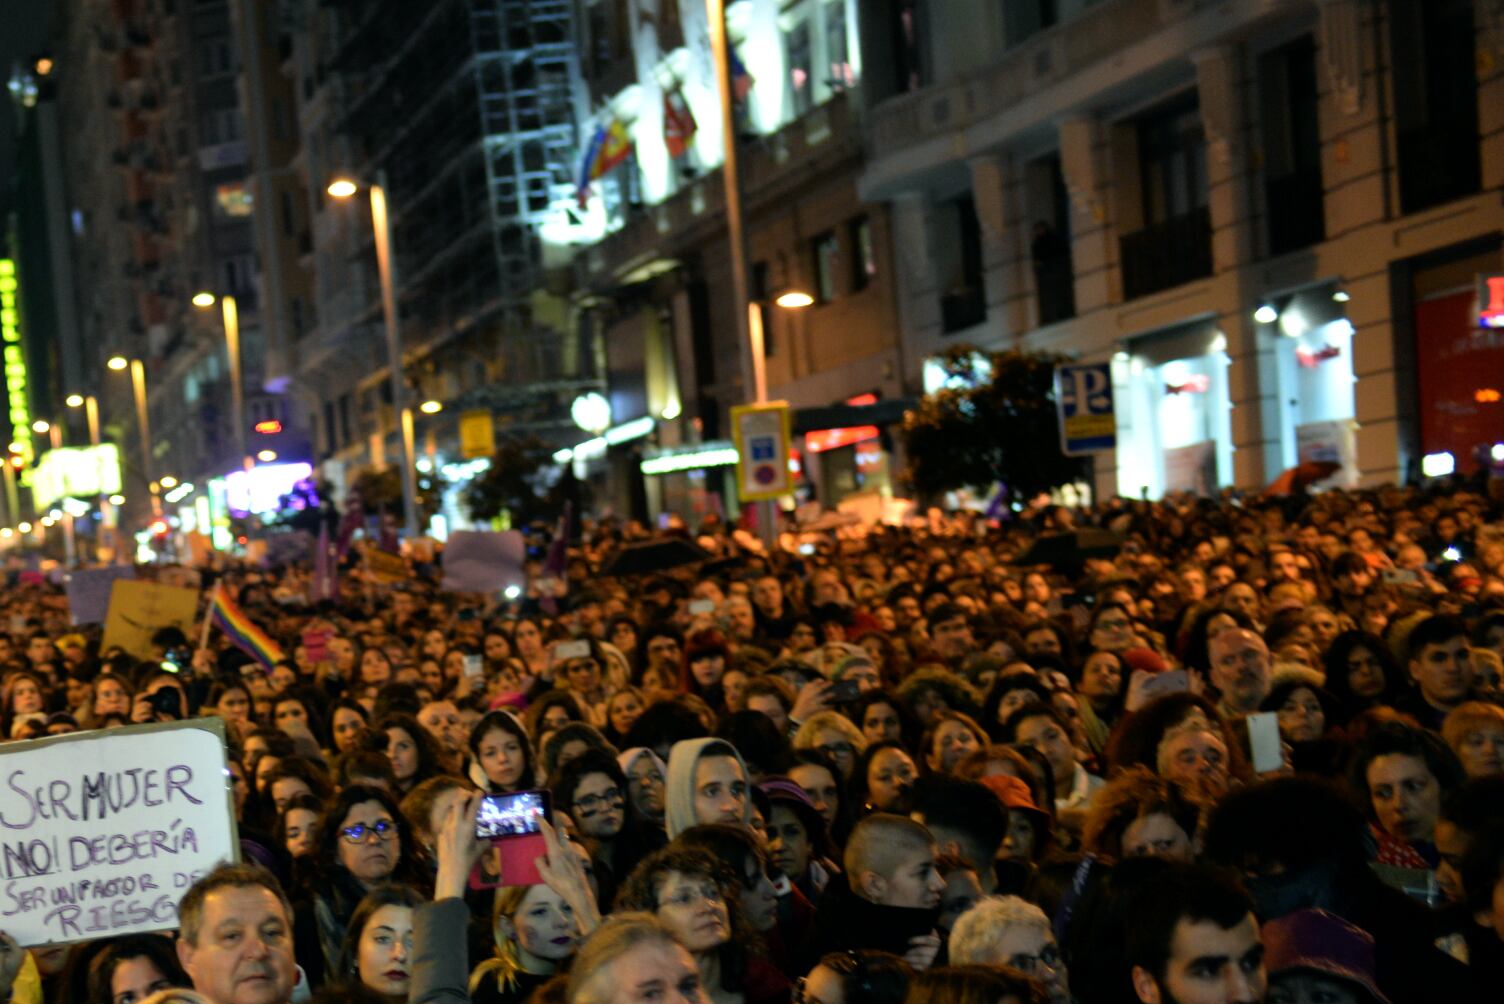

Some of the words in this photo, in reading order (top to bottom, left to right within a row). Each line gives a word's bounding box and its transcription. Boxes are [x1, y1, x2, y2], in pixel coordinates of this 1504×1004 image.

[82, 764, 203, 821] MUJER
[2, 881, 46, 916] SER
[43, 894, 179, 938] RIESG
